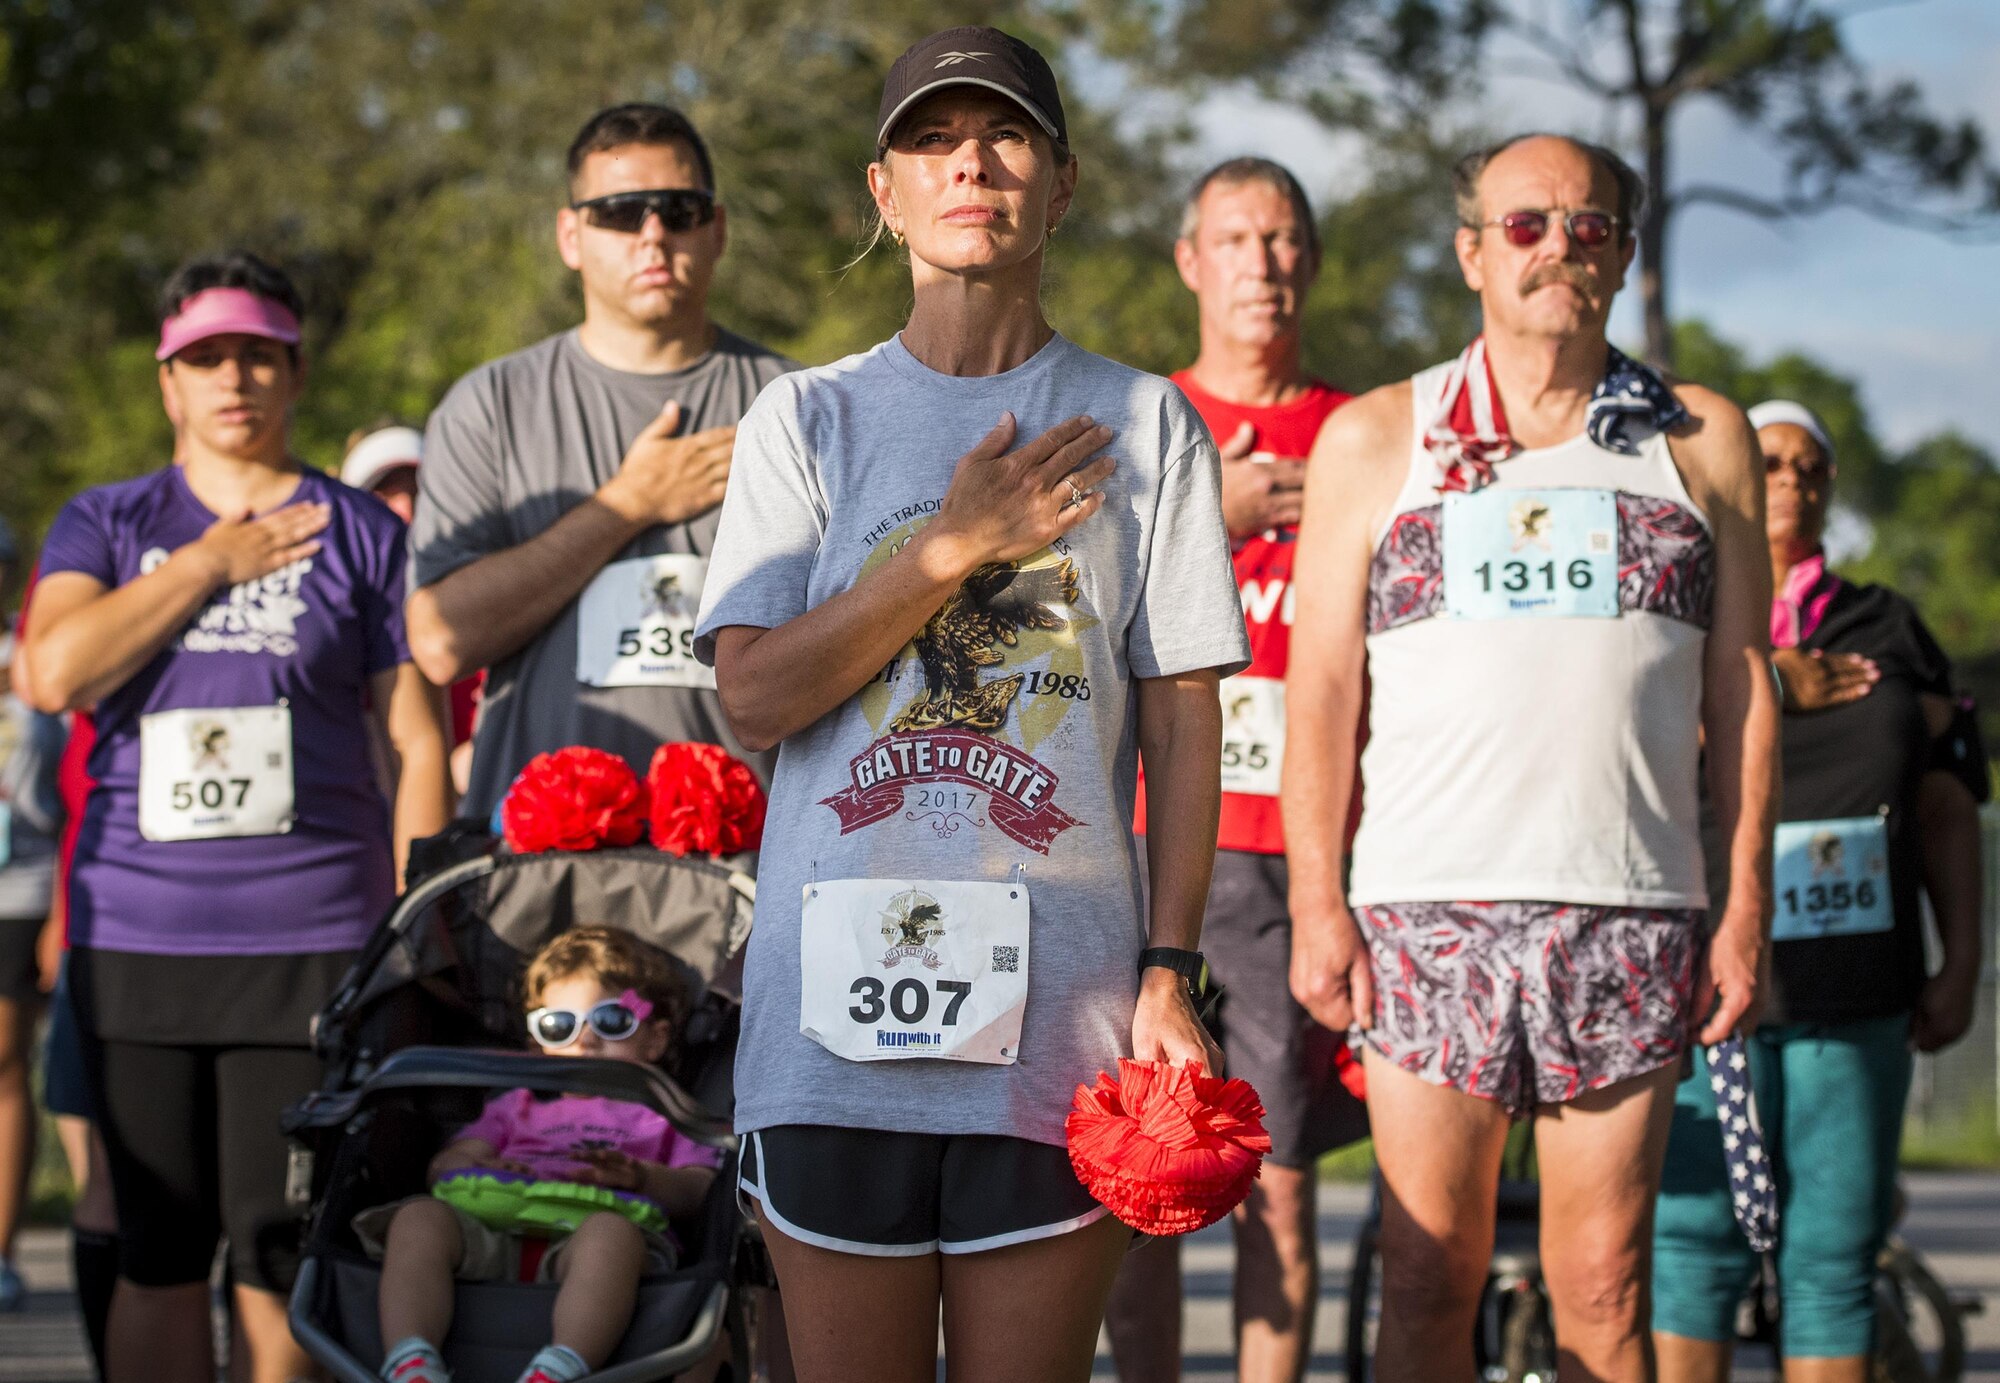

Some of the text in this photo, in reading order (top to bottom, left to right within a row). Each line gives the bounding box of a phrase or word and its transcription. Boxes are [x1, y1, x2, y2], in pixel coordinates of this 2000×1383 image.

[862, 518, 894, 548] THE
[1474, 559, 1594, 593] 1316
[1025, 670, 1092, 702] 1985
[1222, 740, 1270, 770] 55
[856, 741, 1049, 809] GATE TO GATE
[172, 779, 252, 811] 507
[917, 790, 977, 811] 2017
[1784, 880, 1877, 915] 1356
[887, 948, 907, 960] GATE
[915, 948, 937, 961] GATE
[848, 976, 972, 1026] 307
[934, 1032, 942, 1045] it
